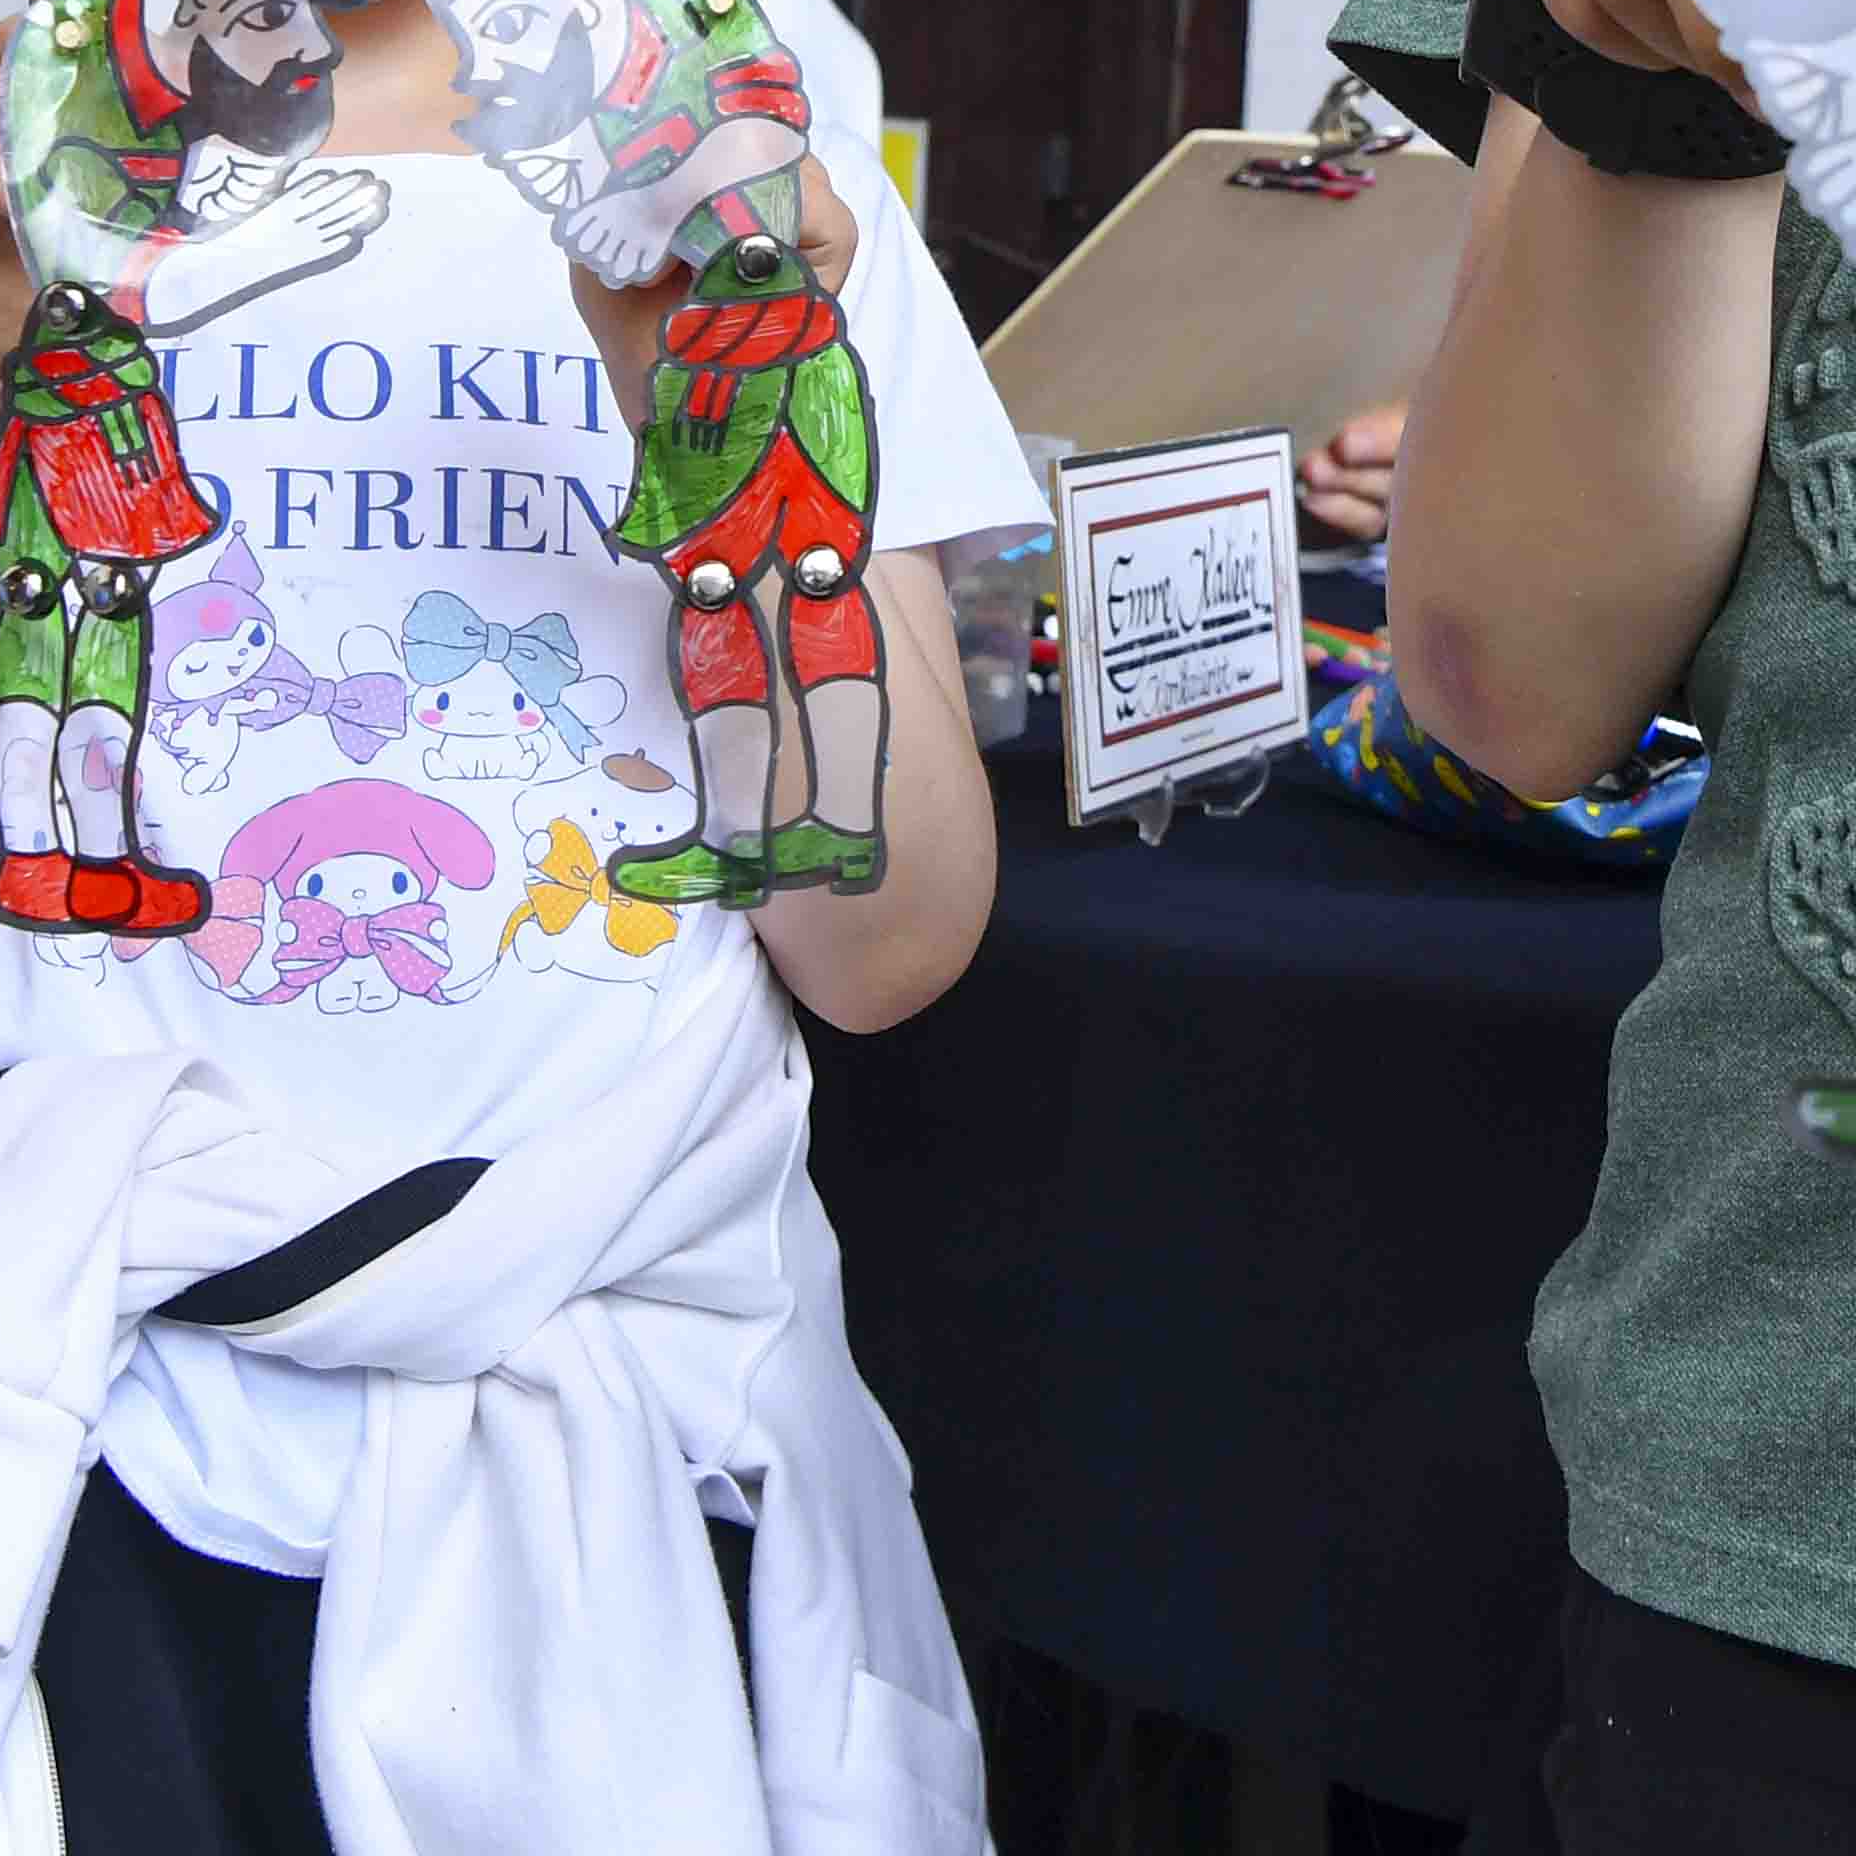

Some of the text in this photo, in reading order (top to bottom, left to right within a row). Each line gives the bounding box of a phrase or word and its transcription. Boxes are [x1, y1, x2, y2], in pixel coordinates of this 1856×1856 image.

[154, 340, 608, 434] LLO KIT
[262, 466, 628, 566] FRIEN
